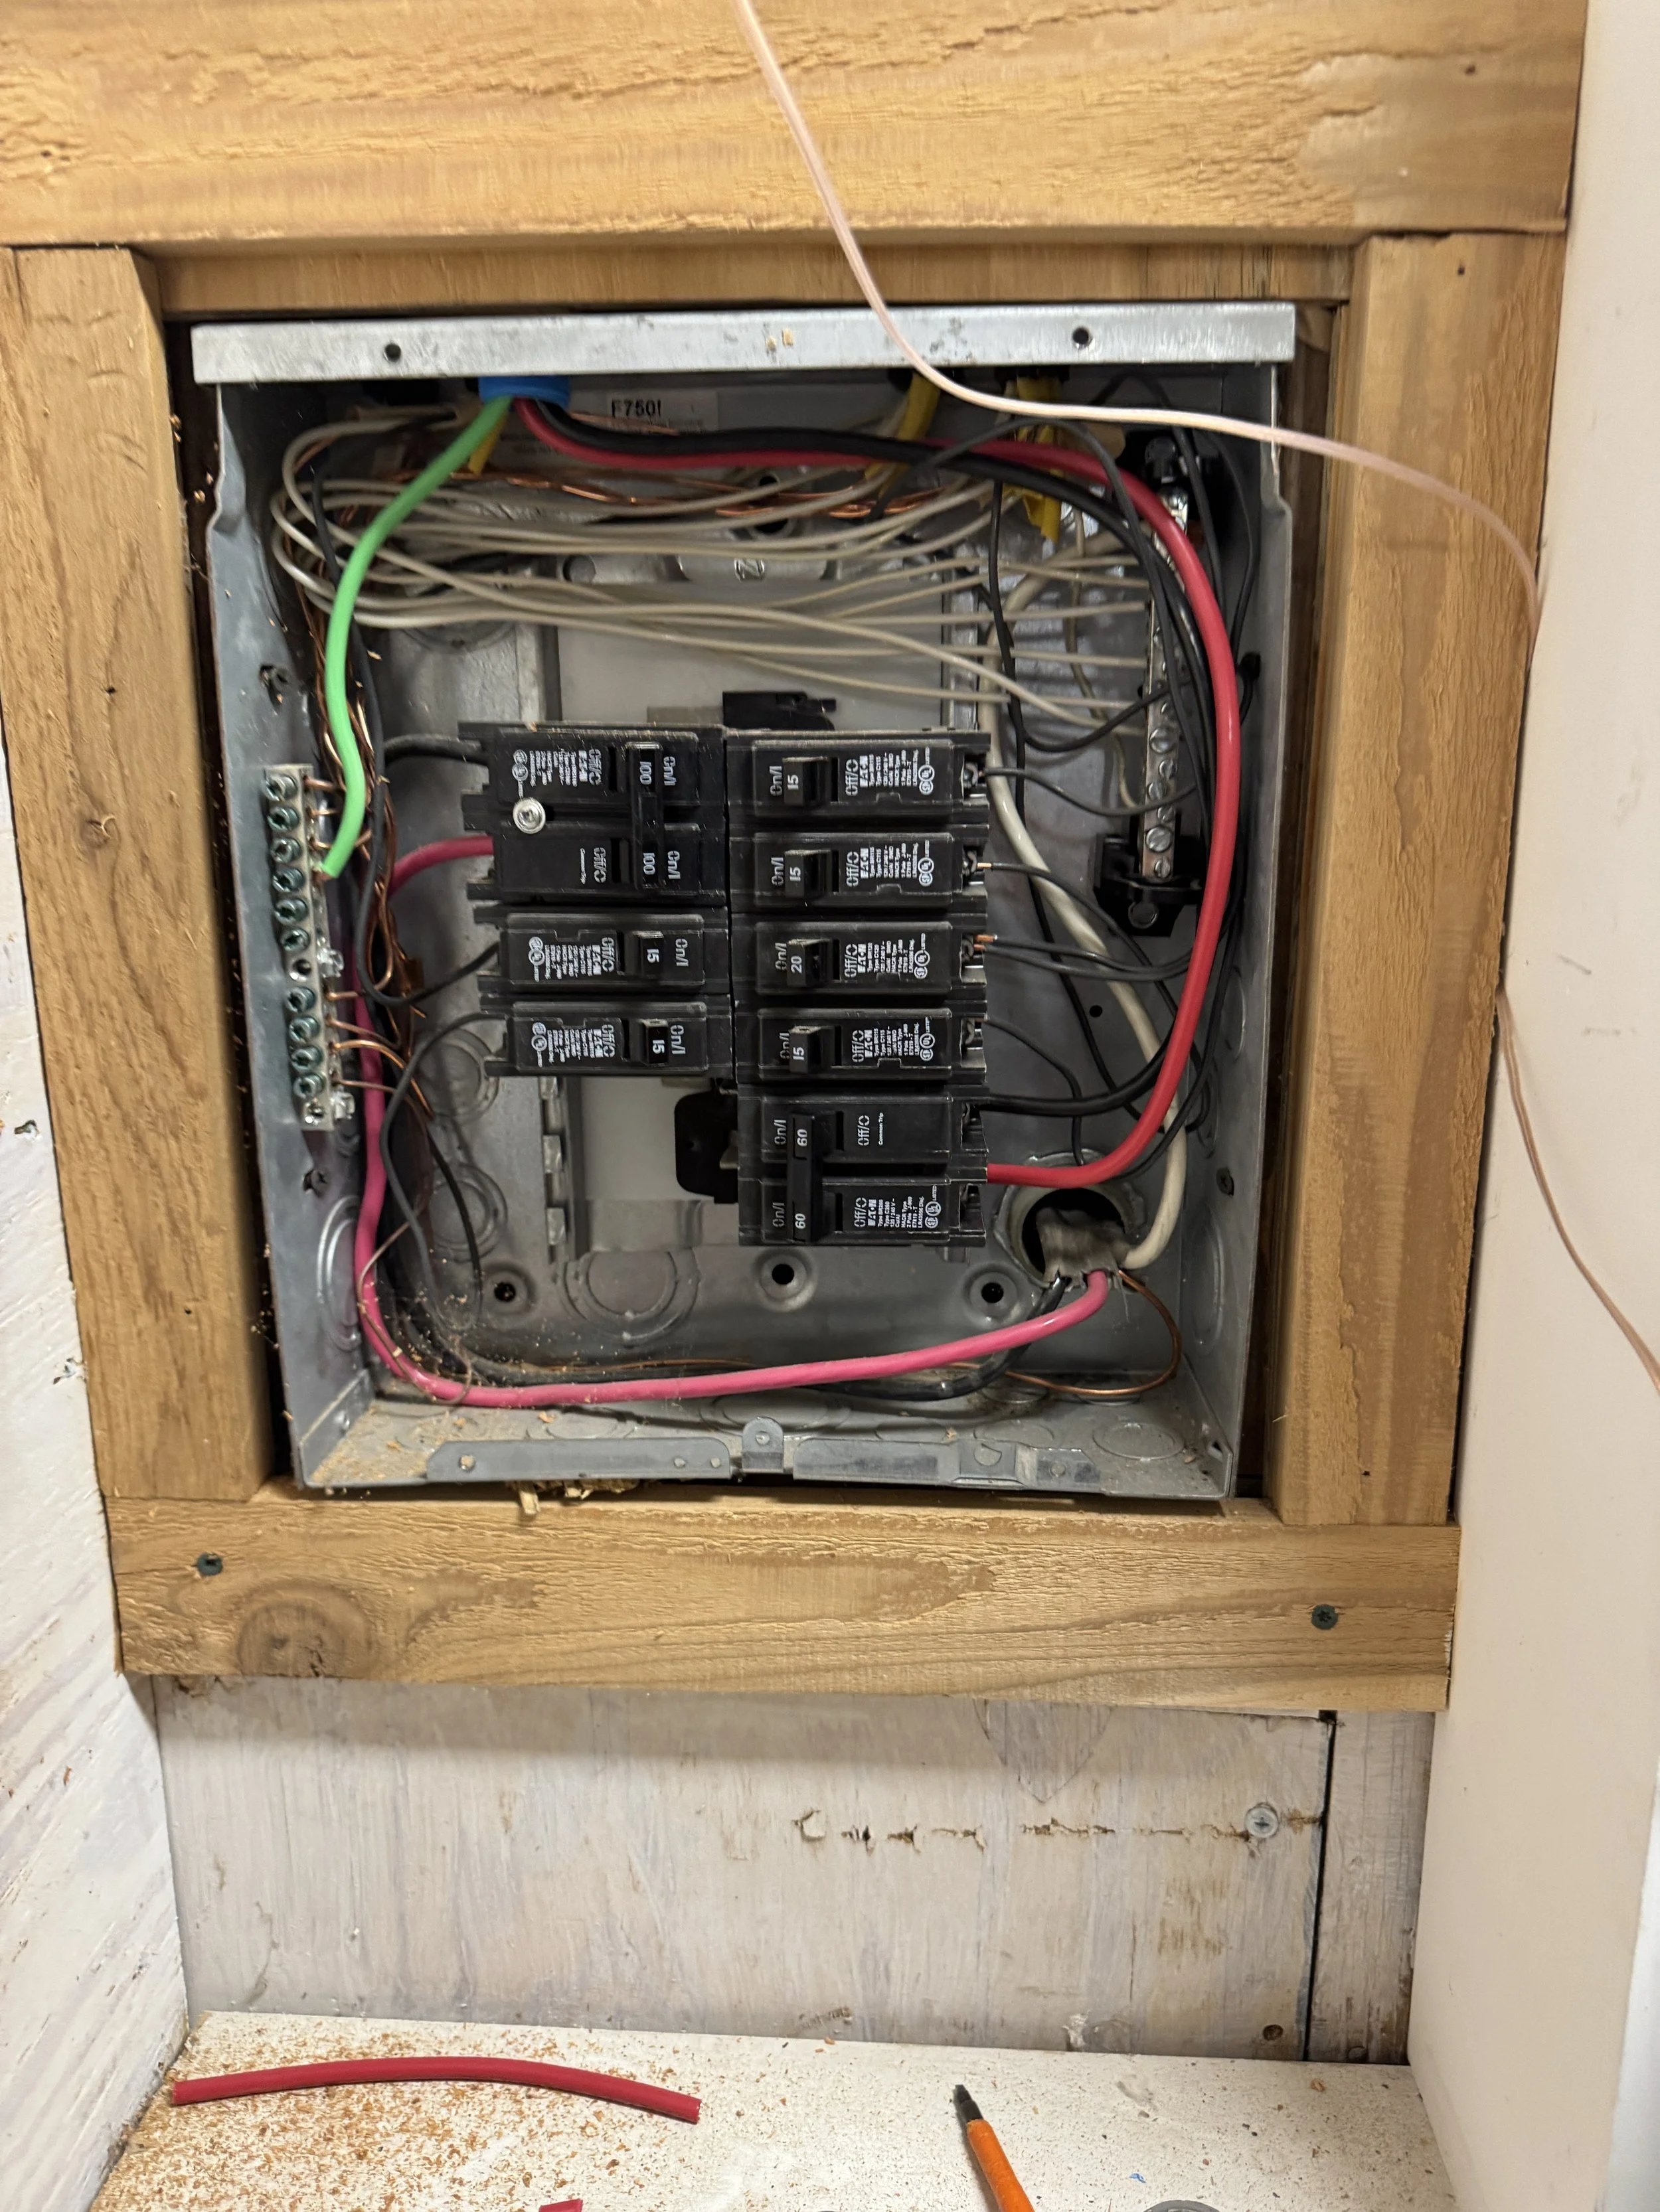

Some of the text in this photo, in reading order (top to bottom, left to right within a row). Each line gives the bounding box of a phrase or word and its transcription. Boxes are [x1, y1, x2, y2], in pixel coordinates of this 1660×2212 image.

[788, 775, 799, 791] 15
[789, 866, 801, 882] 15
[647, 948, 660, 963] 15
[791, 955, 803, 974] 20
[653, 1039, 665, 1054] 15
[865, 1030, 873, 1058] EATON
[792, 1047, 805, 1062] 15
[797, 1129, 807, 1147] 60
[795, 1213, 806, 1229] 60
[868, 1200, 876, 1226] EATON
